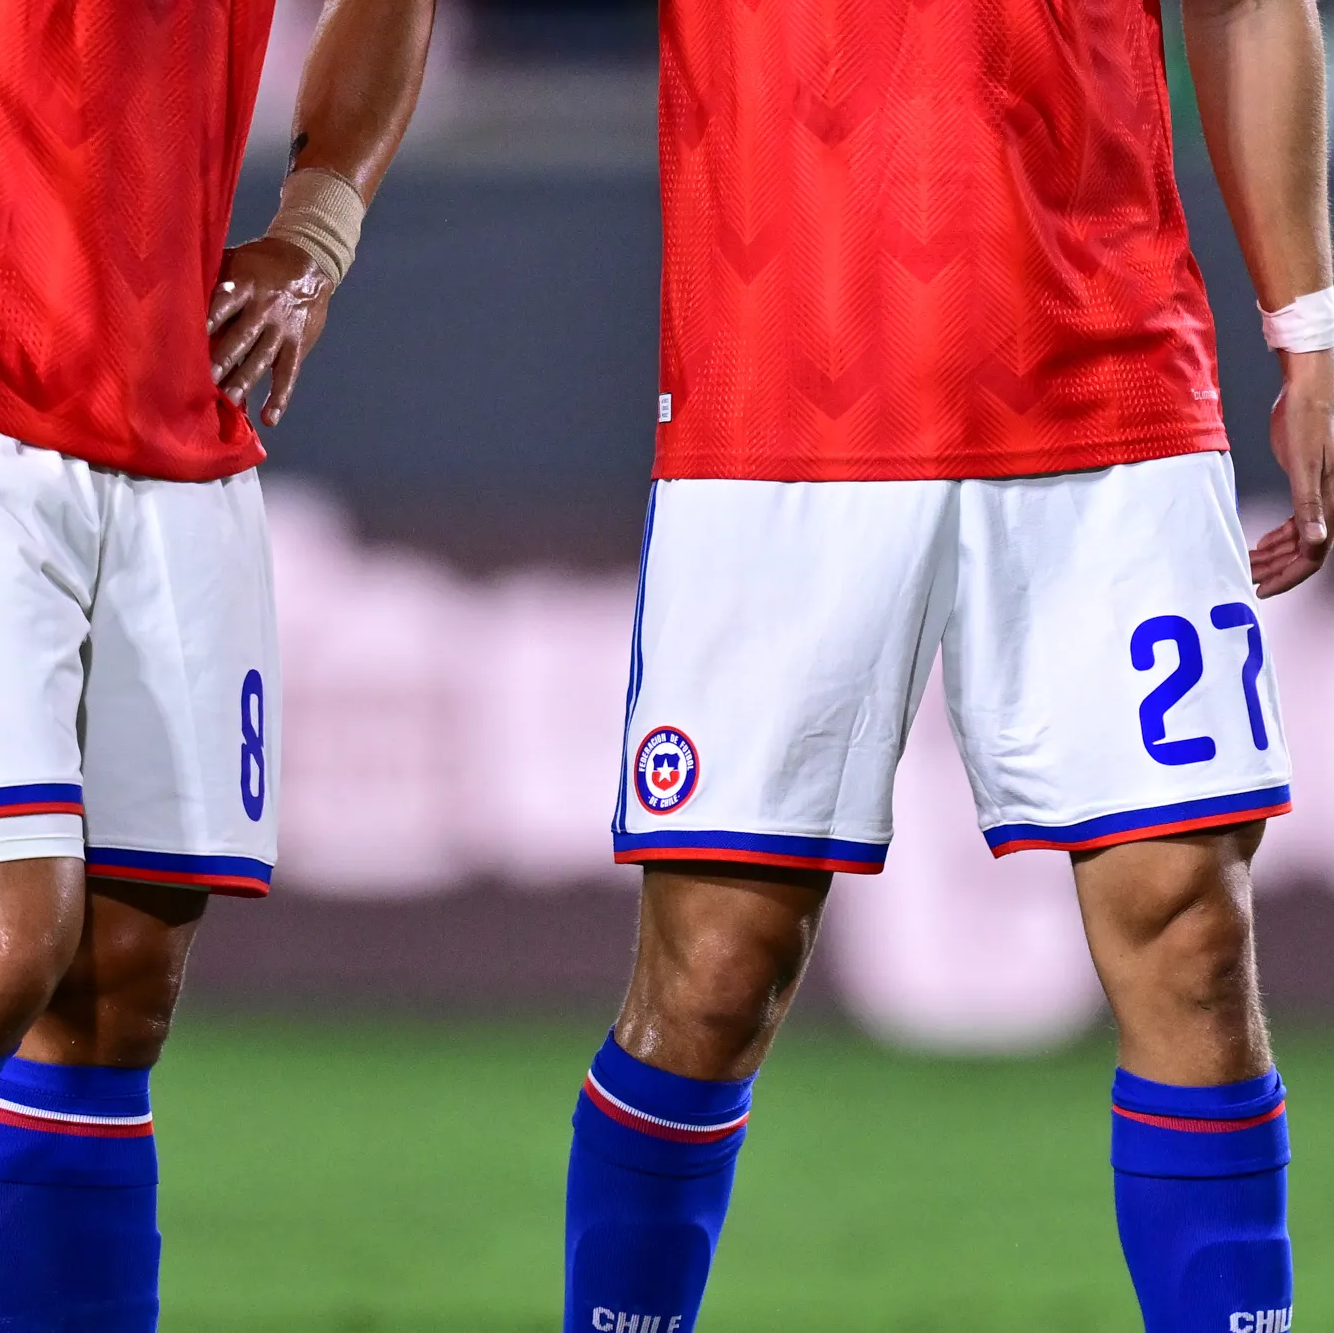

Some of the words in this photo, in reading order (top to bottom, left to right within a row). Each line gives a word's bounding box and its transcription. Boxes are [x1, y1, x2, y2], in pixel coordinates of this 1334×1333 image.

[1130, 602, 1268, 766] 27
[241, 669, 265, 822] 8
[639, 733, 666, 772] FEDERACION
[670, 733, 679, 744] DE
[680, 741, 694, 771] FUTBOL
[649, 796, 658, 807] DE
[660, 794, 678, 808] CHILE
